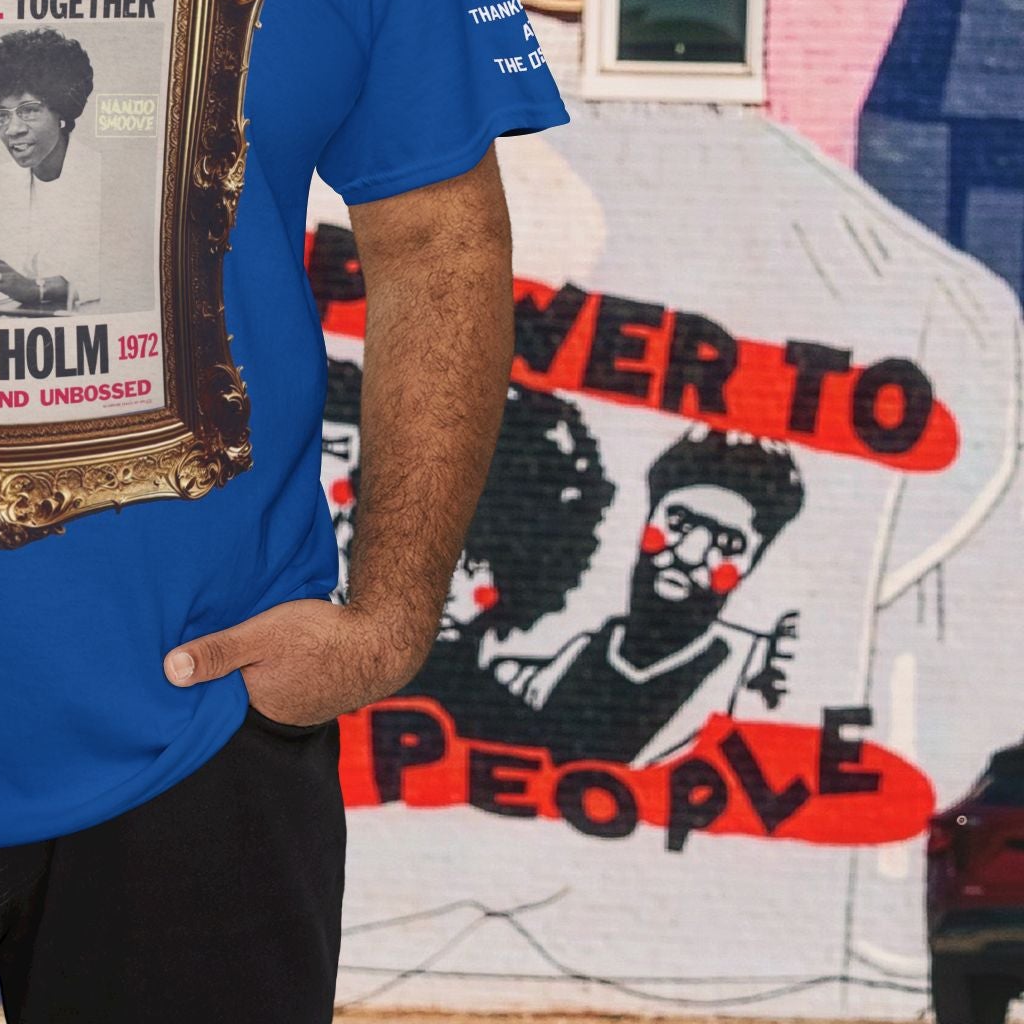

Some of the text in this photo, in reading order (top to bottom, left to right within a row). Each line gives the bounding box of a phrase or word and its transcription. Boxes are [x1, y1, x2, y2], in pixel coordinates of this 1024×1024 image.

[494, 56, 527, 74] THE
[100, 98, 155, 115] NANDO
[98, 114, 155, 131] SMOOVE
[117, 332, 159, 361] 1972
[308, 222, 934, 455] PWER TO
[39, 379, 152, 407] UNBOSSED
[370, 707, 883, 853] PEOPLE
